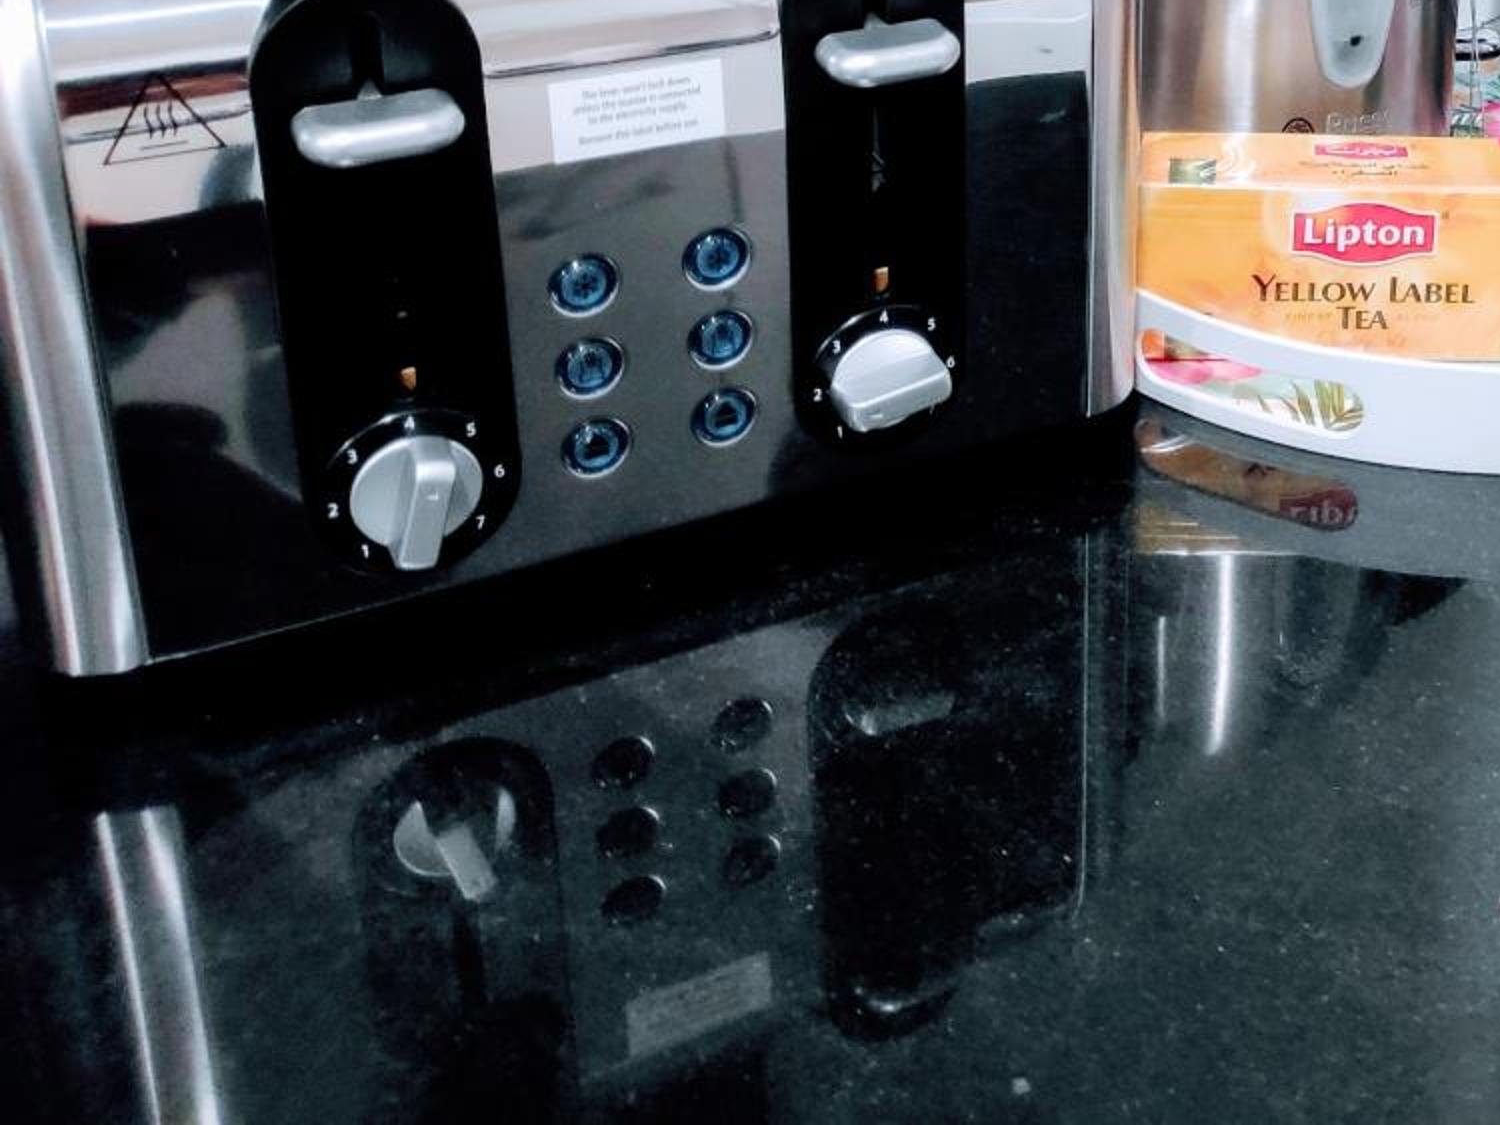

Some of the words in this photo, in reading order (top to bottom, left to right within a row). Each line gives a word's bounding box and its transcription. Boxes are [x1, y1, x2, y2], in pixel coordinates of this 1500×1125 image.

[1303, 217, 1426, 252] Lipton
[1252, 274, 1376, 304] YELLOW
[1388, 276, 1476, 305] LABEL
[879, 308, 889, 323] 4
[1336, 305, 1388, 331] TEA
[927, 317, 936, 332] 5
[832, 340, 841, 354] 3
[946, 356, 956, 368] 6
[813, 388, 823, 402] 2
[404, 415, 415, 430] 4
[465, 422, 477, 437] 5
[837, 426, 843, 439] 1
[347, 449, 358, 464] 3
[494, 464, 506, 478] 6
[327, 503, 339, 519] 2
[476, 515, 486, 530] 7
[361, 544, 369, 558] 1
